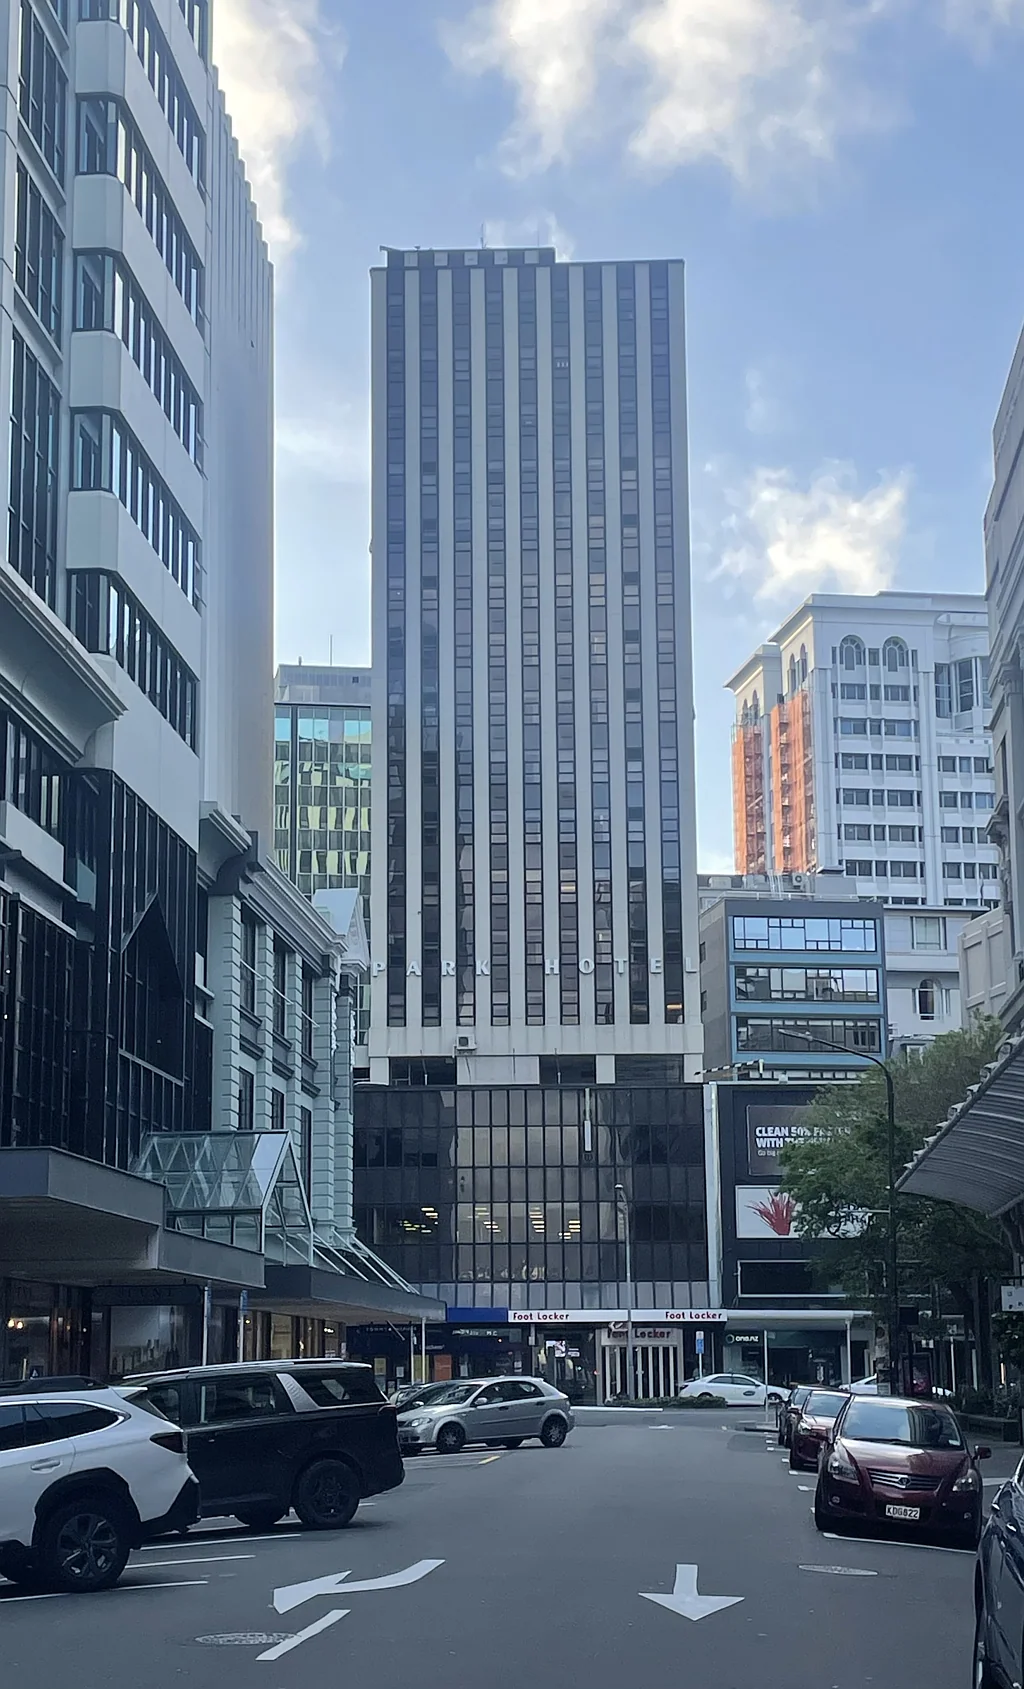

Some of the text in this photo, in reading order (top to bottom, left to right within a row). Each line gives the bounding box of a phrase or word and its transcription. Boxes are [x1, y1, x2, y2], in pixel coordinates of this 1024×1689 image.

[372, 956, 698, 977] PARK HOTEL
[755, 1126, 789, 1137] CLEAN
[755, 1137, 784, 1148] WITH
[513, 1312, 570, 1321] Foot Locker
[665, 1311, 722, 1320] Foot Locker
[634, 1328, 671, 1339] Locker
